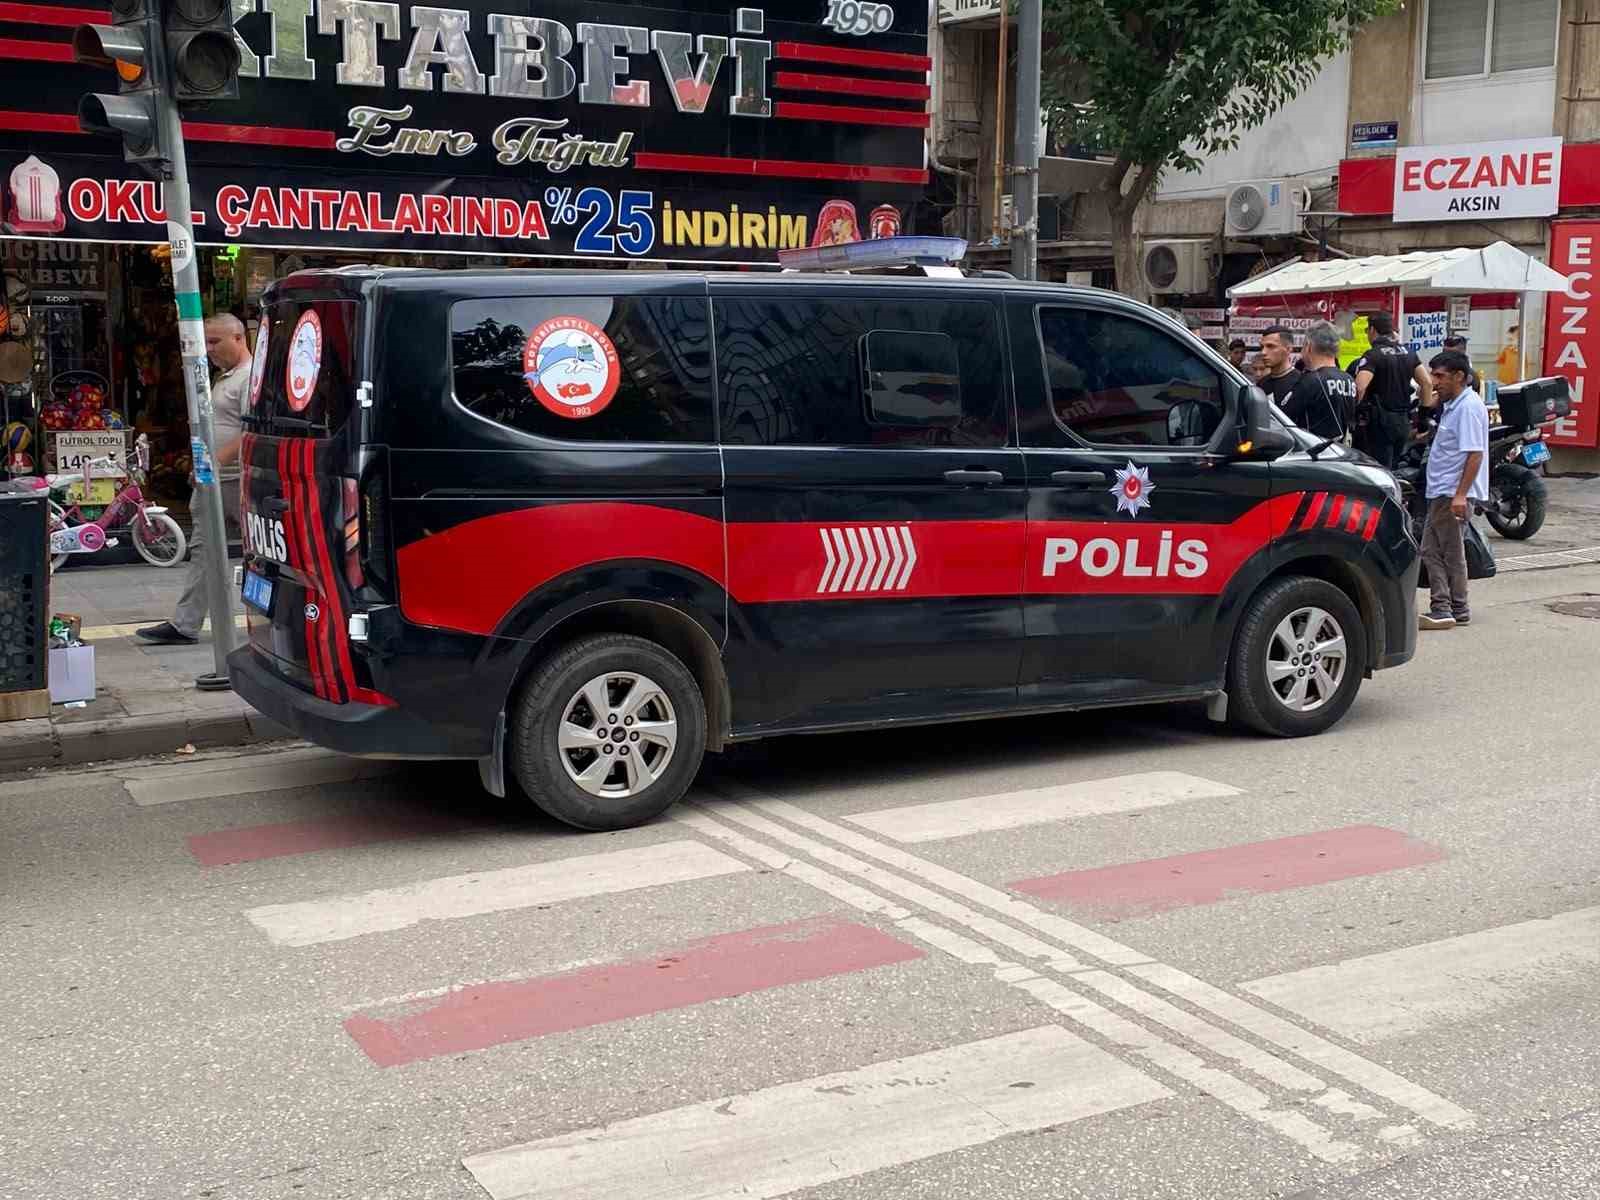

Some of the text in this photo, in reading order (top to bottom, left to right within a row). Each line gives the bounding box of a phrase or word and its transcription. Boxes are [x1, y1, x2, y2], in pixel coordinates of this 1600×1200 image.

[822, 0, 894, 36] 1950
[336, 105, 634, 173] Emre Tuğrul
[1403, 152, 1553, 192] ECZANE
[216, 185, 549, 237] ÇANTALARINDA
[544, 187, 655, 255] %25
[662, 201, 807, 250] İNDİRİM
[1447, 196, 1500, 212] AKSIN
[60, 437, 94, 445] FUTBOL
[247, 511, 287, 562] POLİS
[1042, 530, 1209, 578] POLİS
